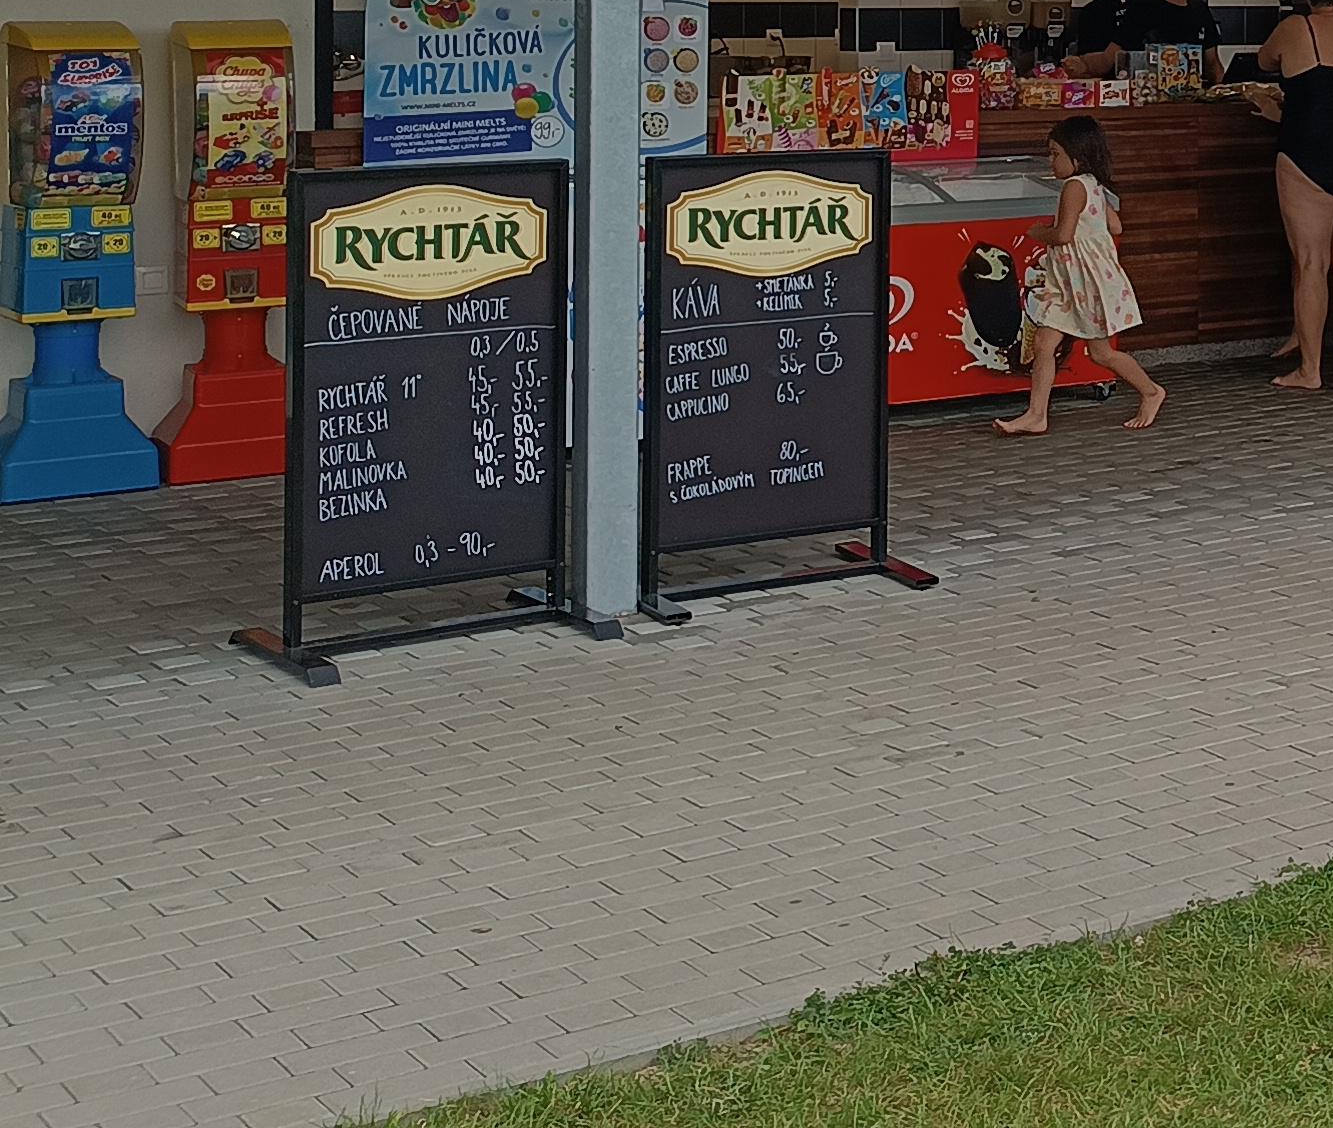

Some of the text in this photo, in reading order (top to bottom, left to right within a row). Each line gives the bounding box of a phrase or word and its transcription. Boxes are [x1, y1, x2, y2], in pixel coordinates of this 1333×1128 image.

[418, 25, 543, 59] KULIČKOVÁ
[68, 58, 99, 71] TOY
[222, 65, 266, 77] Chupa
[379, 60, 518, 97] ZMRZLINA
[56, 123, 127, 135] mentos
[395, 117, 507, 133] ORIGINÁLNÍ MINI MELTS
[533, 121, 560, 139] 99,-
[335, 211, 532, 271] RYCHTÁŘ
[688, 196, 860, 249] RYCHTÁŘ
[328, 294, 511, 341] ČEPOVANÉ NÁPOJE
[672, 277, 721, 320] KÁVA
[668, 328, 802, 365] ESPRESSO 50,-
[318, 374, 389, 412] RYCHTÁŘ
[468, 365, 498, 394] 45,-
[512, 359, 548, 390] 55,-
[665, 353, 806, 394] CAFFE LUNGO 55,-
[319, 408, 389, 441] REFRESH
[512, 391, 546, 413] 55,-
[666, 382, 806, 421] CAPPUCINO 65,-
[319, 439, 376, 467] KOFOLA
[473, 419, 504, 446] 40,-
[667, 440, 809, 484] FRAPPE 80,-
[319, 461, 407, 494] MALINOVKA
[474, 445, 505, 466] 40,-
[680, 471, 755, 502] ČOKOLÁDOVÝM
[770, 461, 825, 486] TOPINGEM
[319, 460, 546, 522] BEZINKA 40,- 50,-
[319, 553, 384, 583] APEROL
